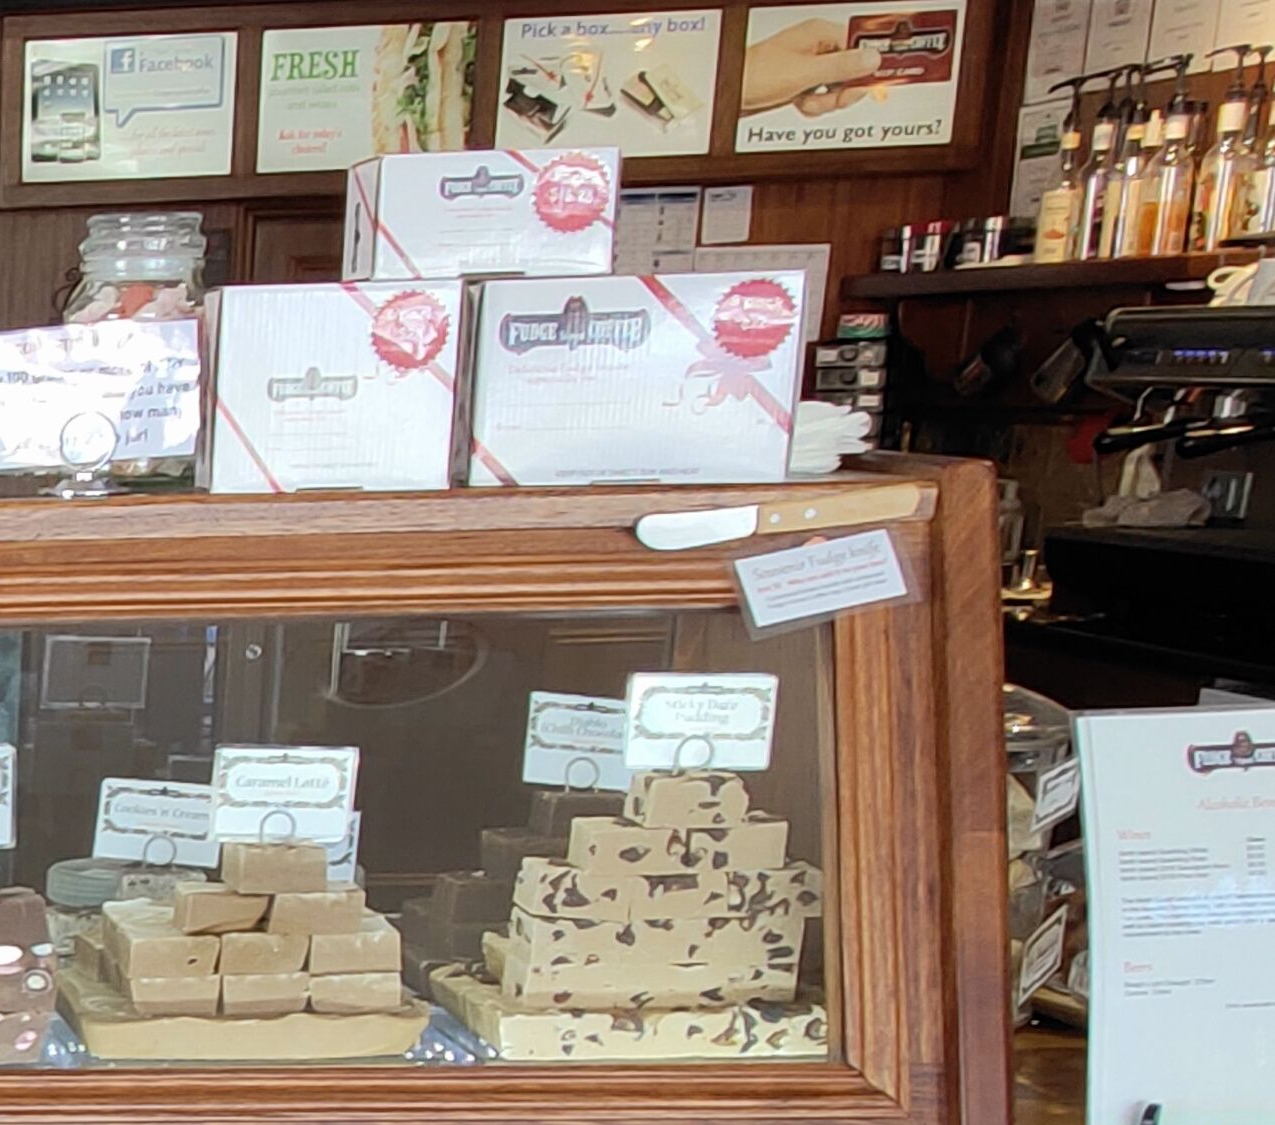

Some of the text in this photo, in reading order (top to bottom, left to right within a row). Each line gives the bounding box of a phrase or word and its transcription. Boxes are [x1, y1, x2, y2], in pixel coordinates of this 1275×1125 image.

[521, 23, 556, 38] Pick
[560, 25, 571, 35] a
[667, 17, 705, 33] box!
[139, 54, 214, 72] Facebook
[270, 49, 359, 81] FRESH
[748, 119, 942, 145] Have you got yours?
[508, 322, 558, 346] FUDGE
[675, 711, 729, 725] Pudding
[236, 775, 292, 788] Caramel
[173, 807, 211, 820] Cream
